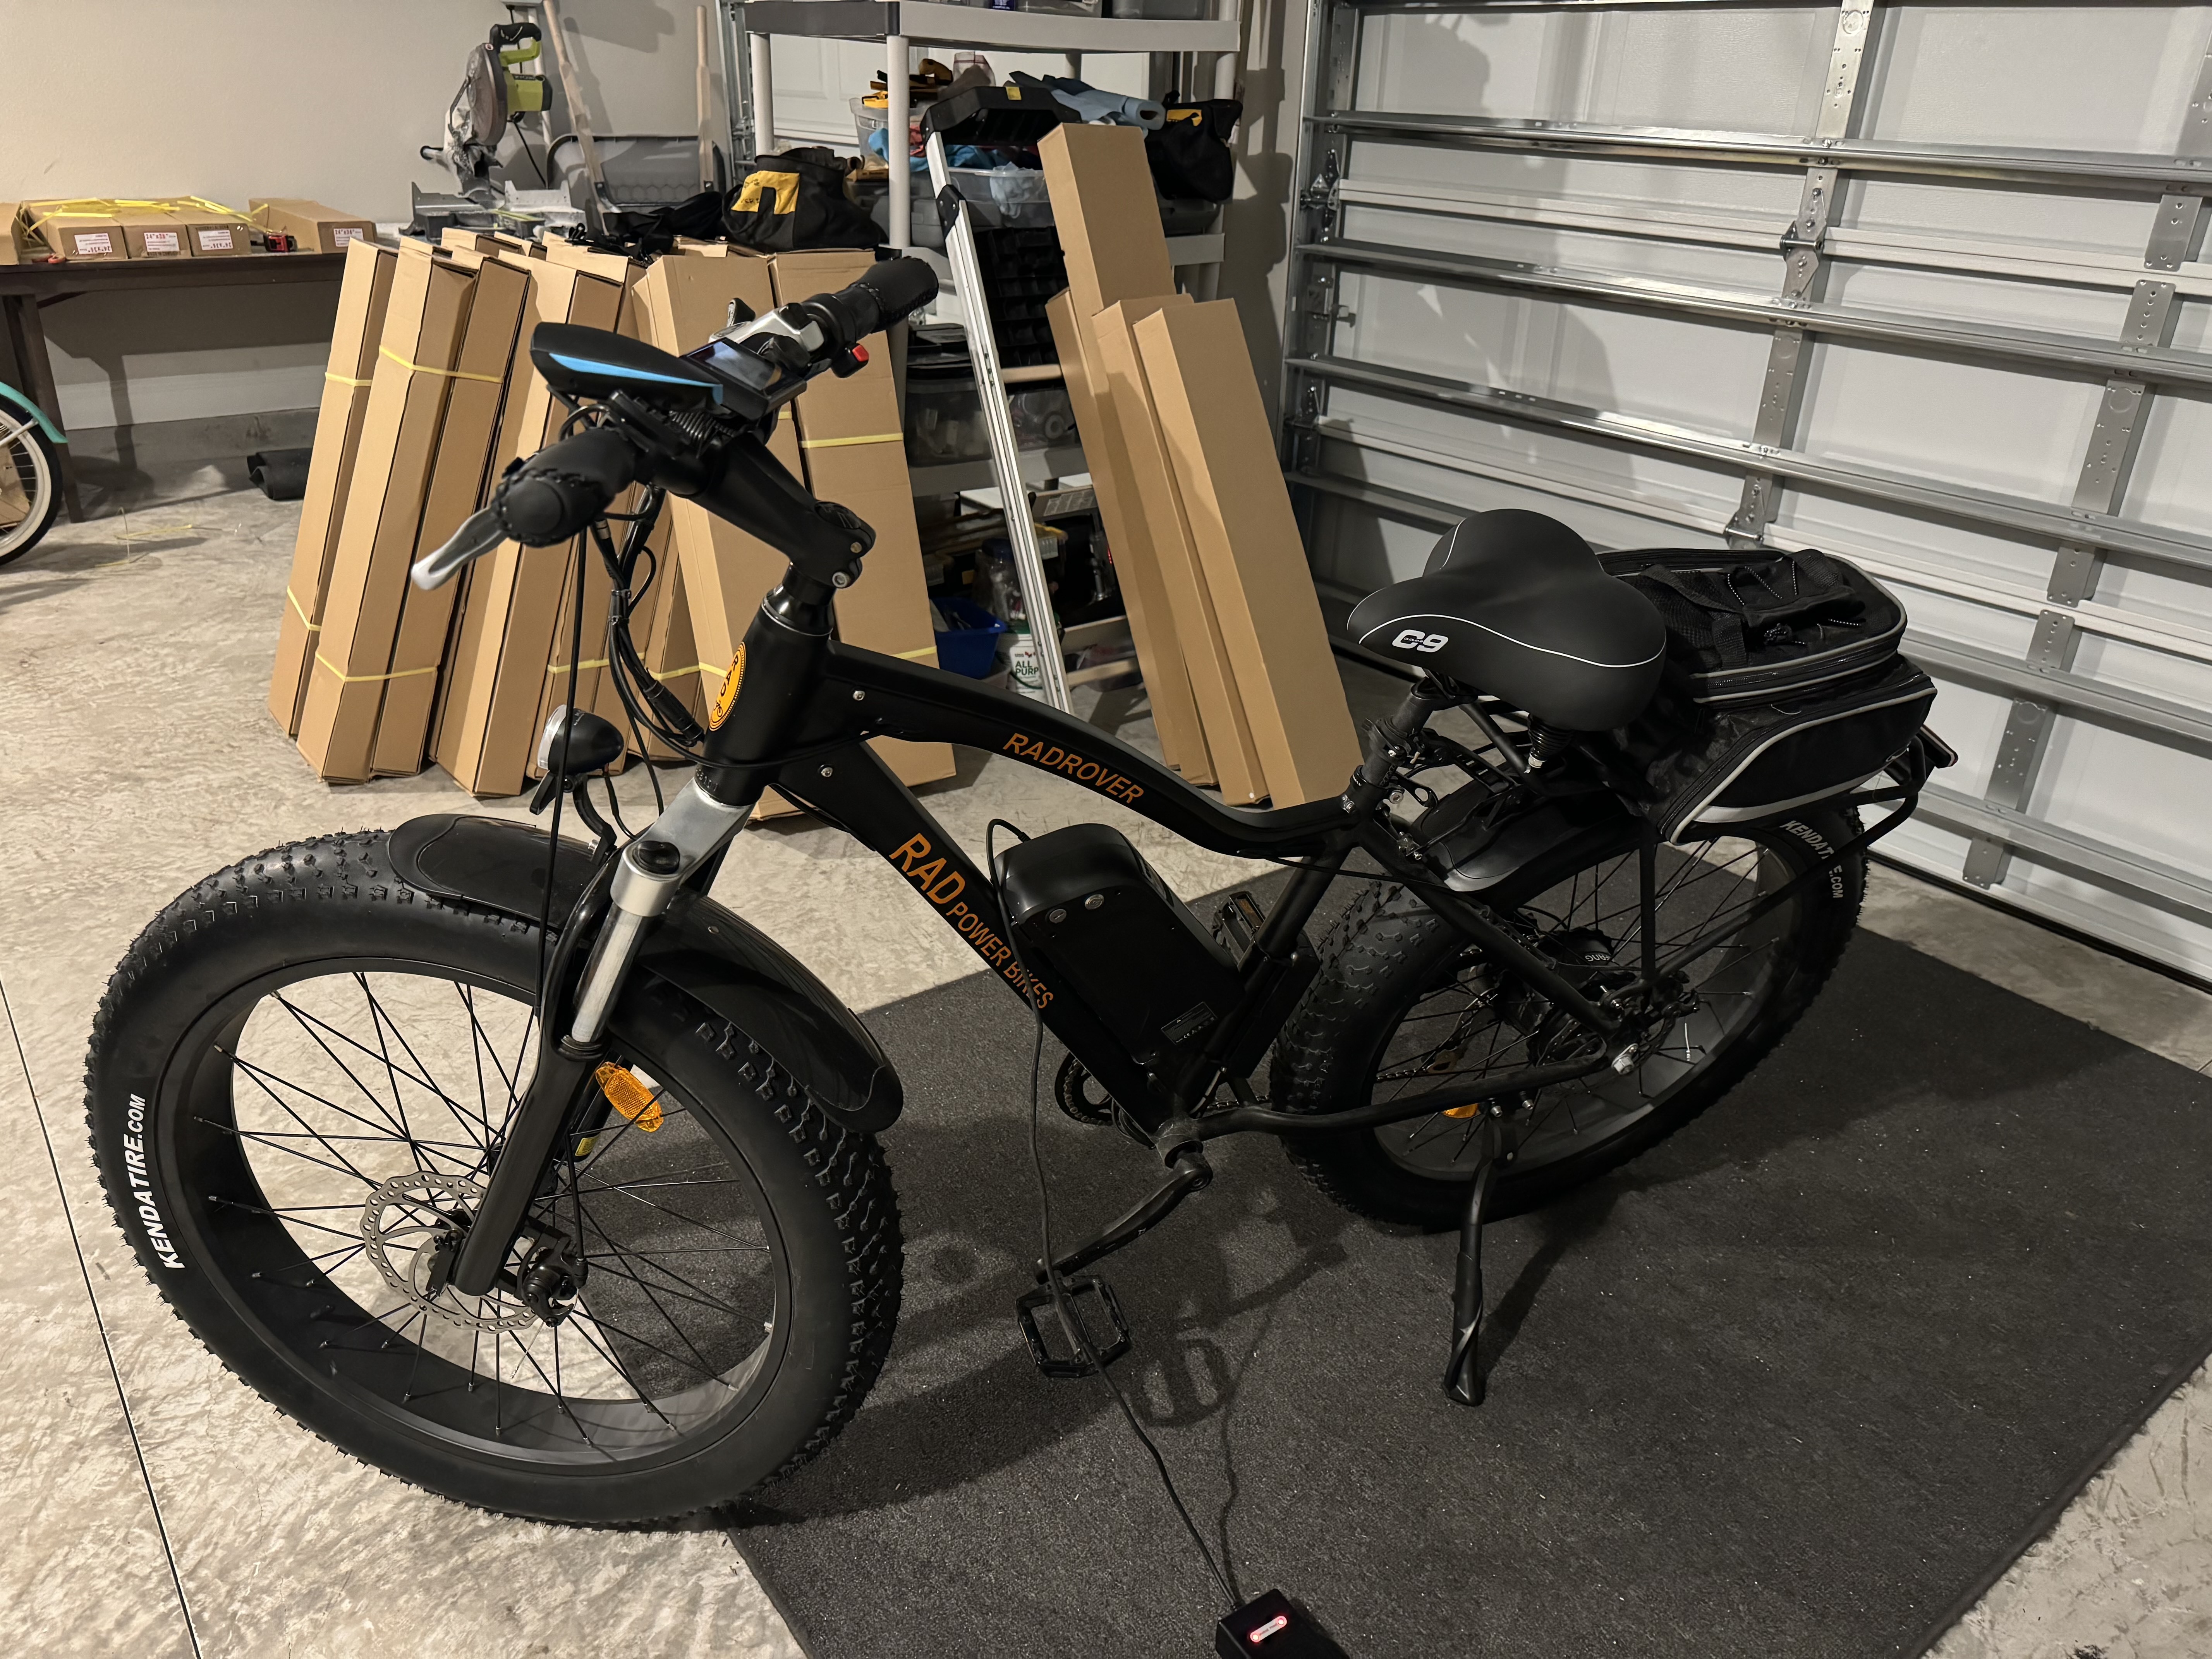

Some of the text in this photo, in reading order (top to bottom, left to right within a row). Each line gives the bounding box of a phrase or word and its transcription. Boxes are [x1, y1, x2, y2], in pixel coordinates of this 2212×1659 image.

[720, 654, 739, 697] RAD
[1003, 733, 1144, 804] RADROVER
[1779, 820, 1843, 898] KENDATE.COM
[889, 833, 965, 904] RAD
[946, 902, 1012, 966] POWER
[124, 1093, 185, 1268] KENDATIRE.COM
